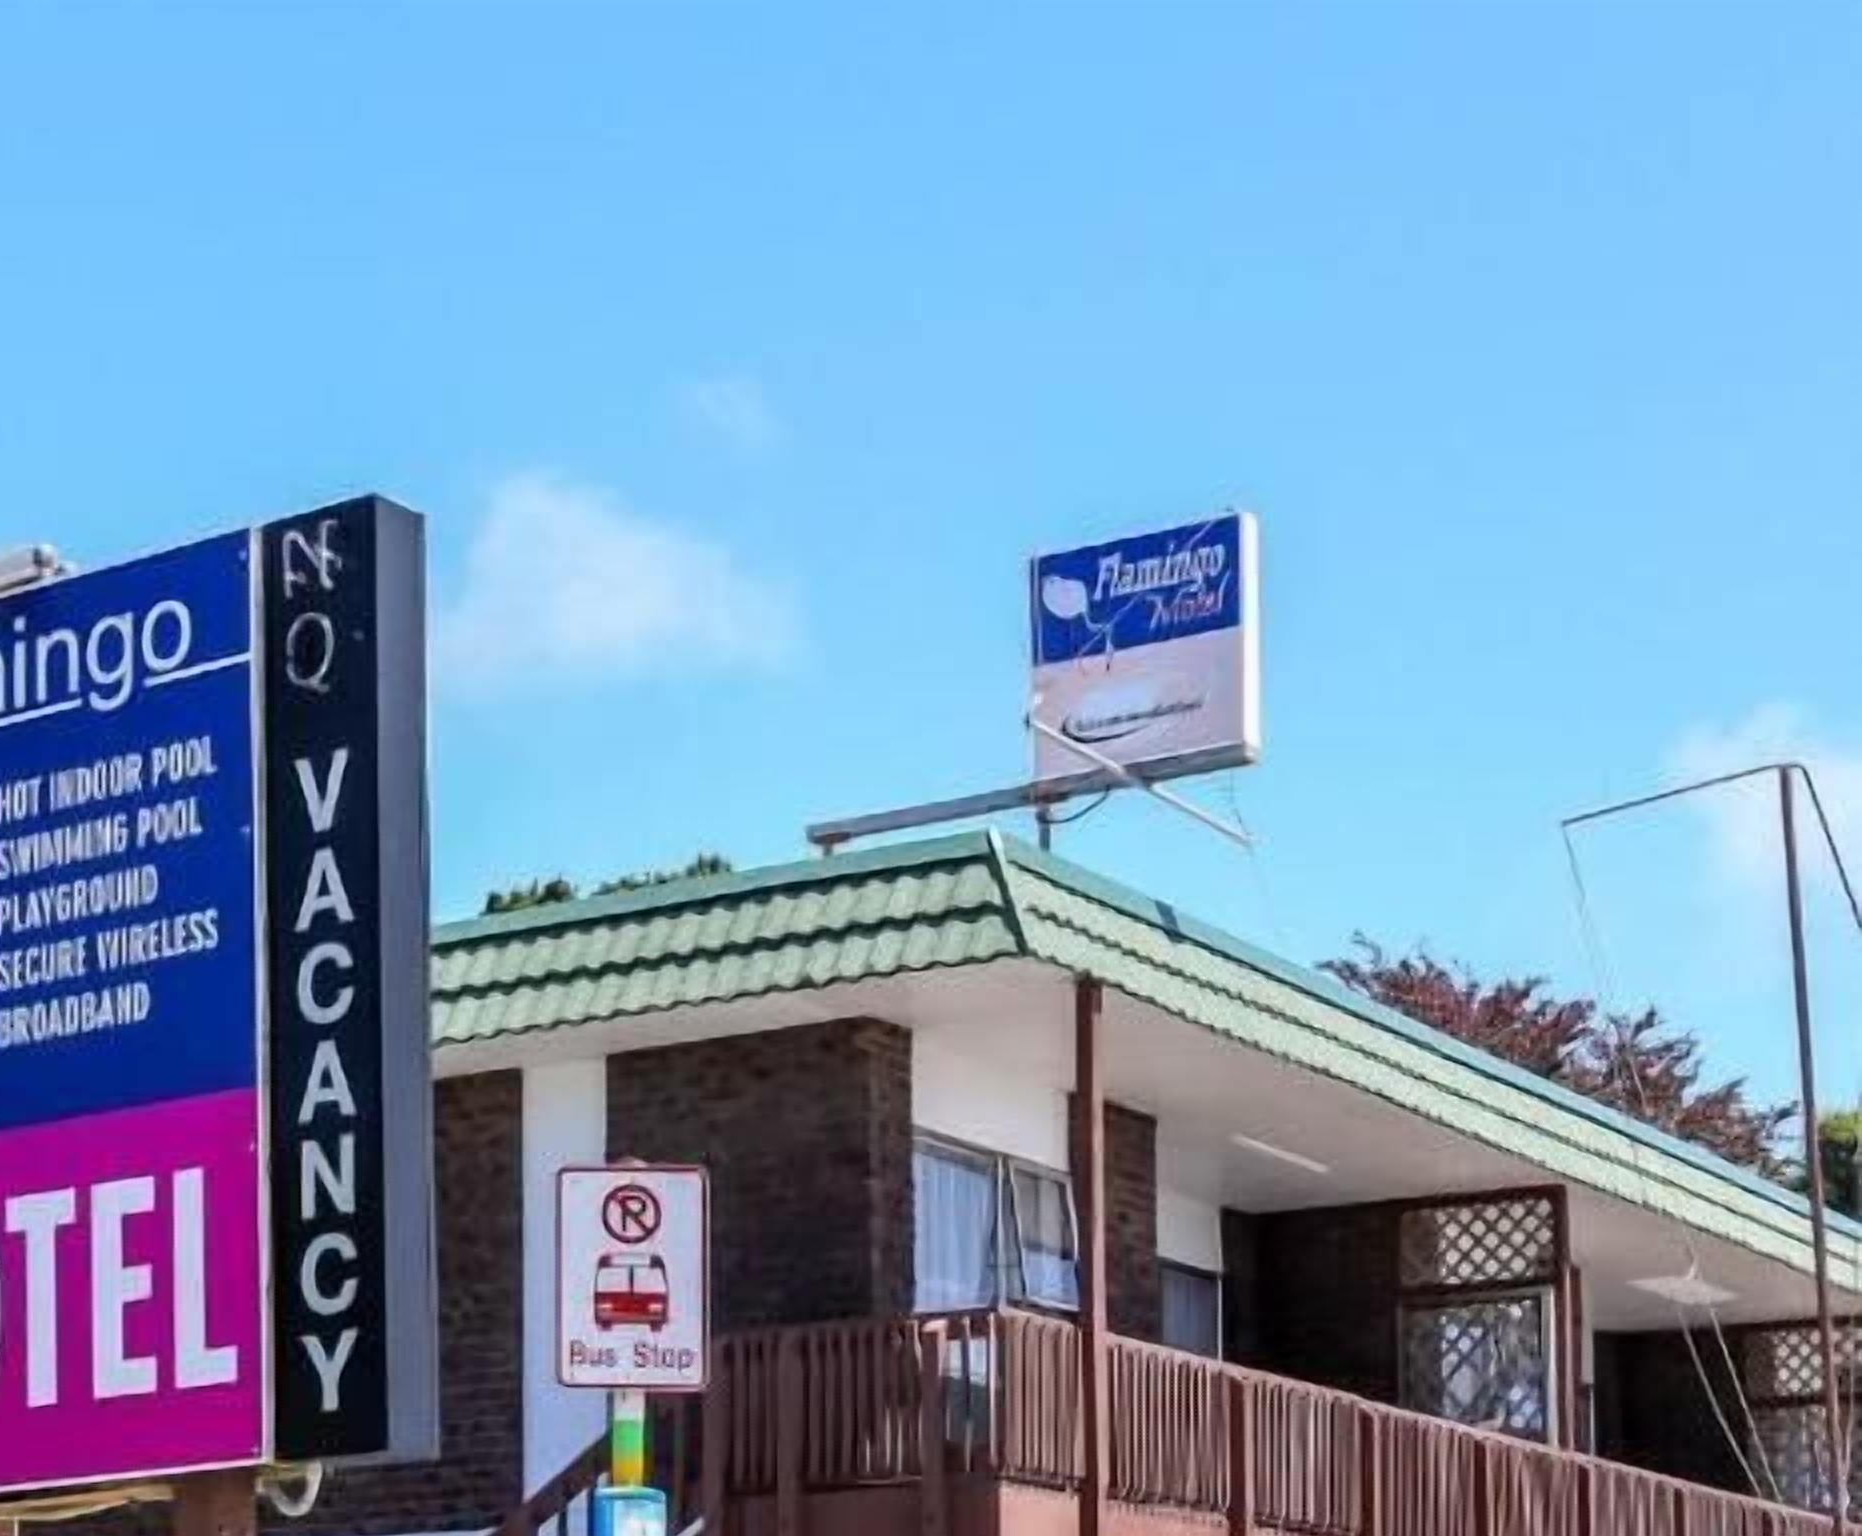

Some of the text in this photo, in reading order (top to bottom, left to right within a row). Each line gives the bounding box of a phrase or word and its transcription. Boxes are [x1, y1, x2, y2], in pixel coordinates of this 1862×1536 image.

[1093, 543, 1225, 601] Flamingo
[49, 753, 144, 813] INDOOR
[151, 735, 218, 788] POOL
[136, 796, 203, 849] POOL
[97, 908, 219, 972] WIRELESS
[294, 748, 358, 1413] VACANCY
[568, 1339, 696, 1373] Bus Stop
